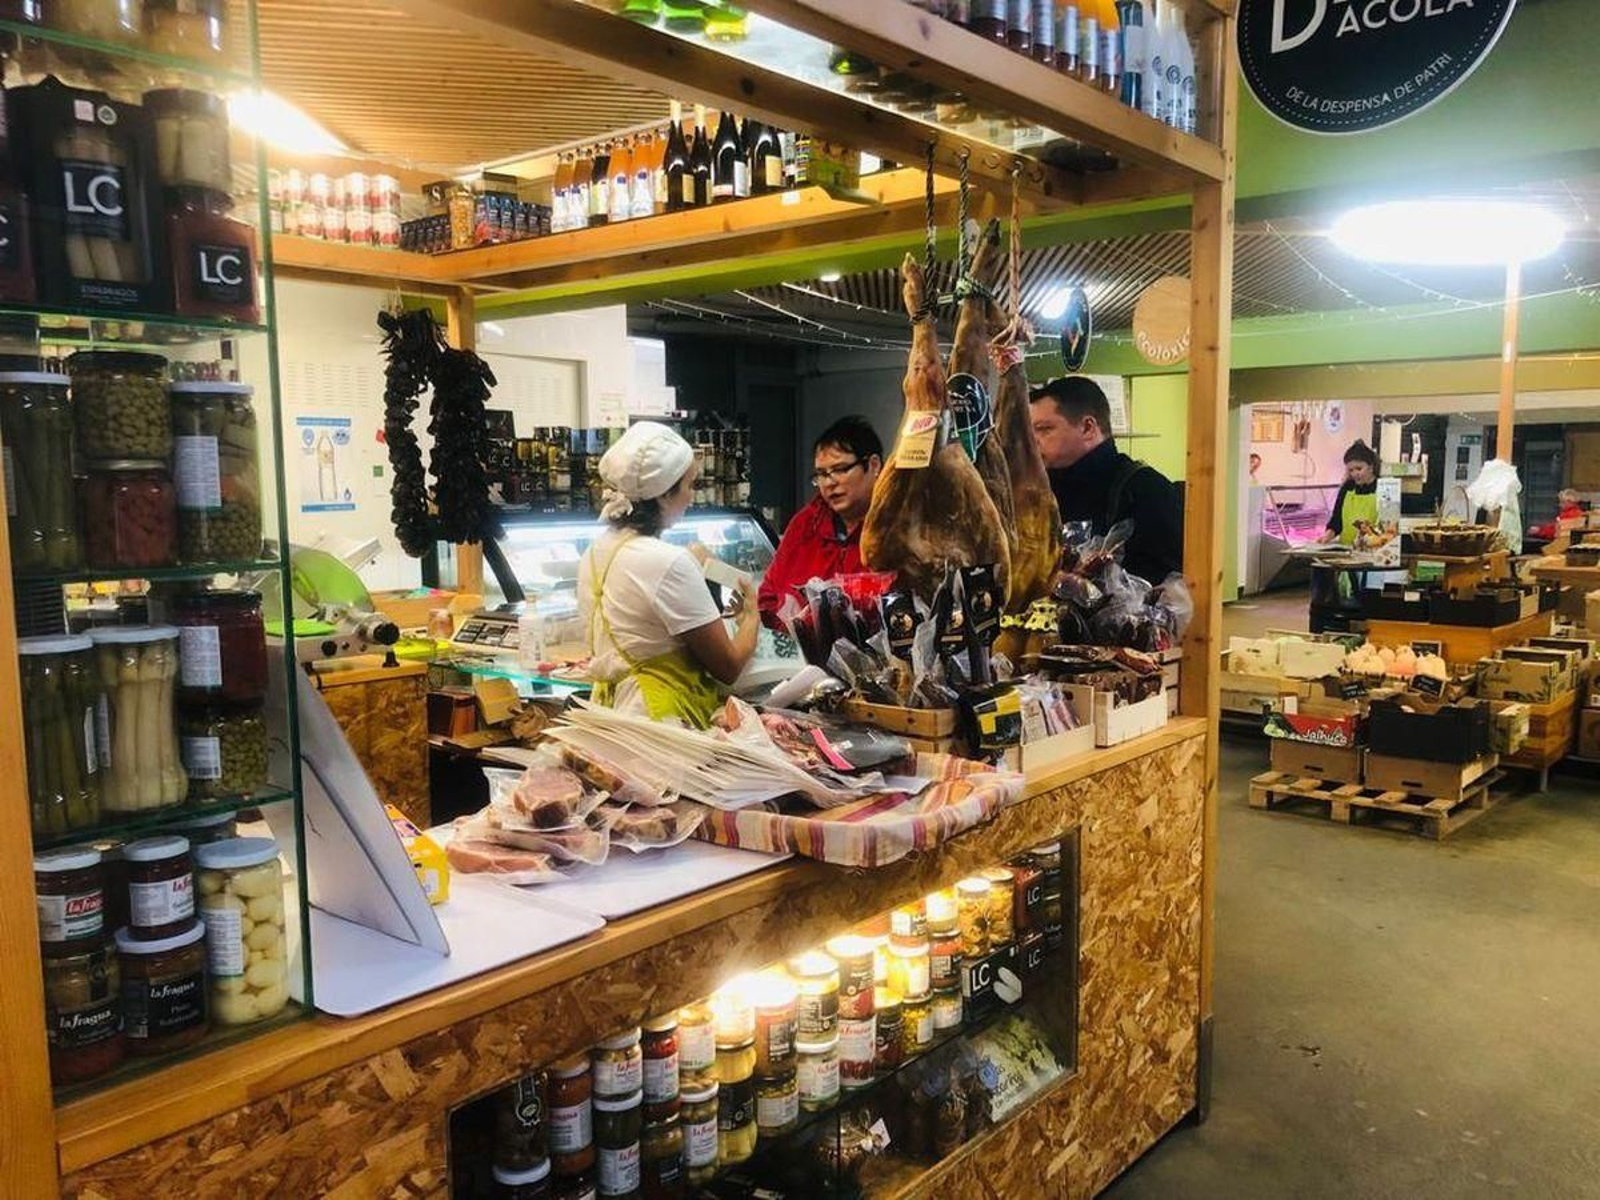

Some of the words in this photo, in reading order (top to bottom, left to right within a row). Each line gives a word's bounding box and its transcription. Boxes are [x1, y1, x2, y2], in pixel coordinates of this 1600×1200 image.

[1285, 86, 1304, 104] DE
[1302, 94, 1319, 112] LA
[1320, 92, 1392, 114] DESPENSA
[1393, 81, 1416, 99] DE
[1415, 53, 1453, 87] PATRI
[63, 171, 124, 217] LC
[200, 251, 244, 286] LC
[1027, 886, 1041, 906] LC
[1028, 948, 1041, 968] LC
[972, 963, 991, 992] LC
